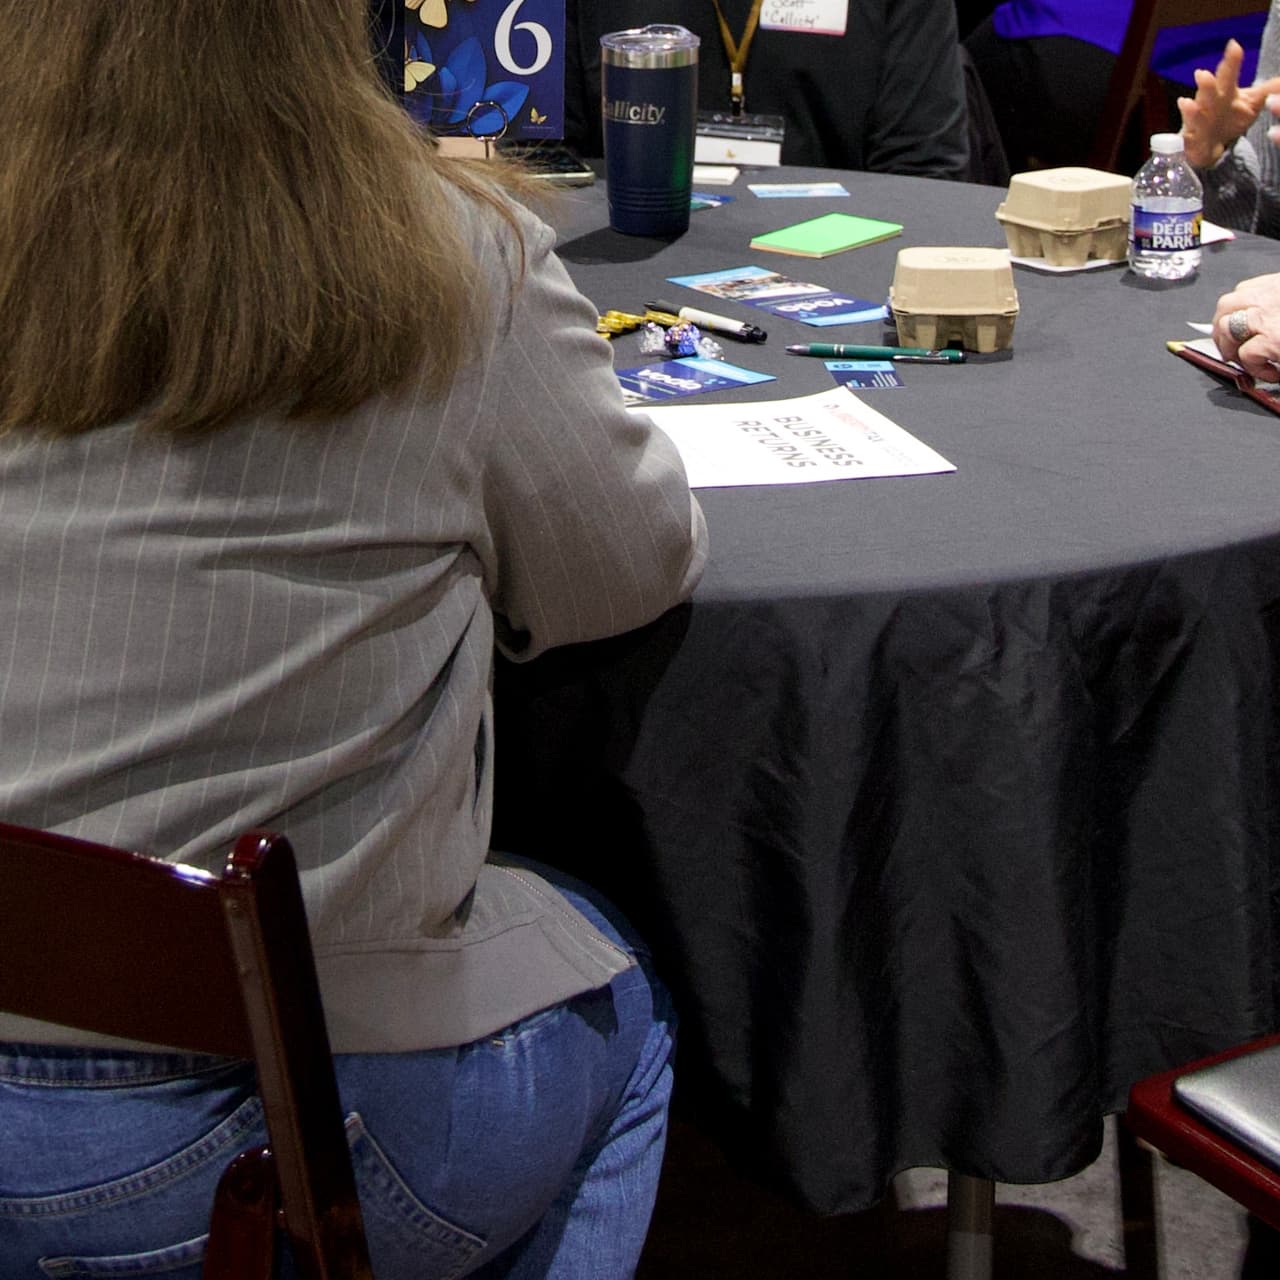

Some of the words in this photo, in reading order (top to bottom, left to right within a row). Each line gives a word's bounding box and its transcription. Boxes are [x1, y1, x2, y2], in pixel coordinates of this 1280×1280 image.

[1152, 222, 1193, 236] DEER
[1152, 234, 1194, 250] PARK
[732, 419, 817, 469] RETURNS
[774, 415, 863, 468] BUSINESS
